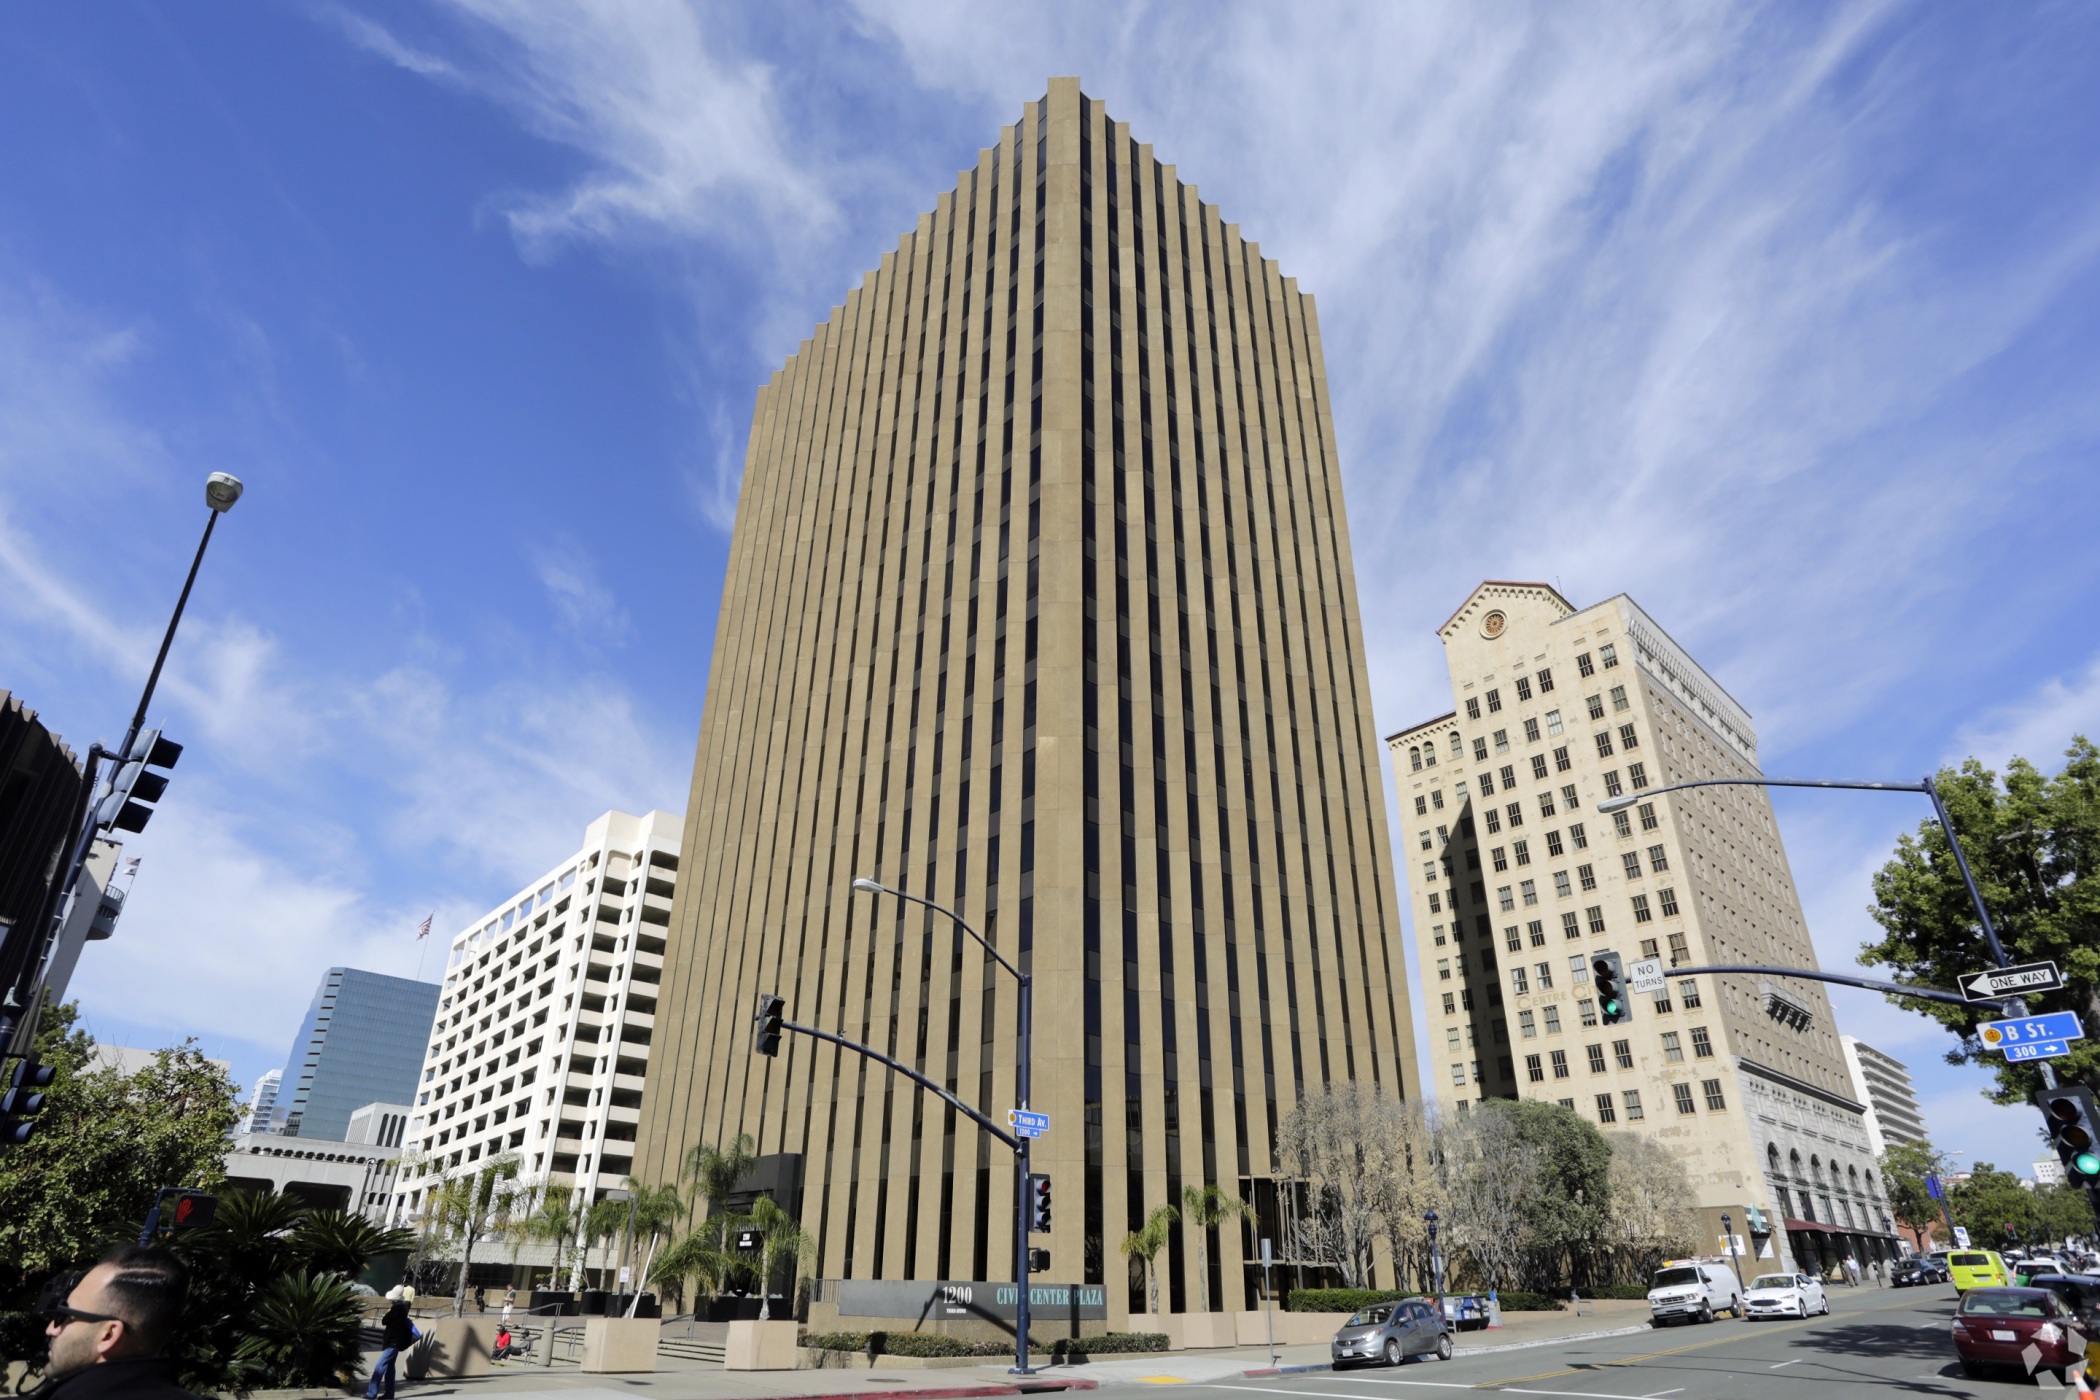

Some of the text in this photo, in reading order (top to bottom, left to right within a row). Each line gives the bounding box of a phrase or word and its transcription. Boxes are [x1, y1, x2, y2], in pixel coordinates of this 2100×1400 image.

[1637, 965, 1654, 976] NO
[1635, 977, 1663, 989] TURNS
[1990, 971, 2047, 989] ONE WAY
[1517, 991, 1568, 1009] CENTRE
[2005, 1025, 2019, 1041] B
[2013, 1045, 2038, 1058] 300
[1018, 1114, 1036, 1126] THIRD
[942, 1286, 973, 1305] 1200
[996, 1287, 1103, 1305] CIVI CENTER PLAZA
